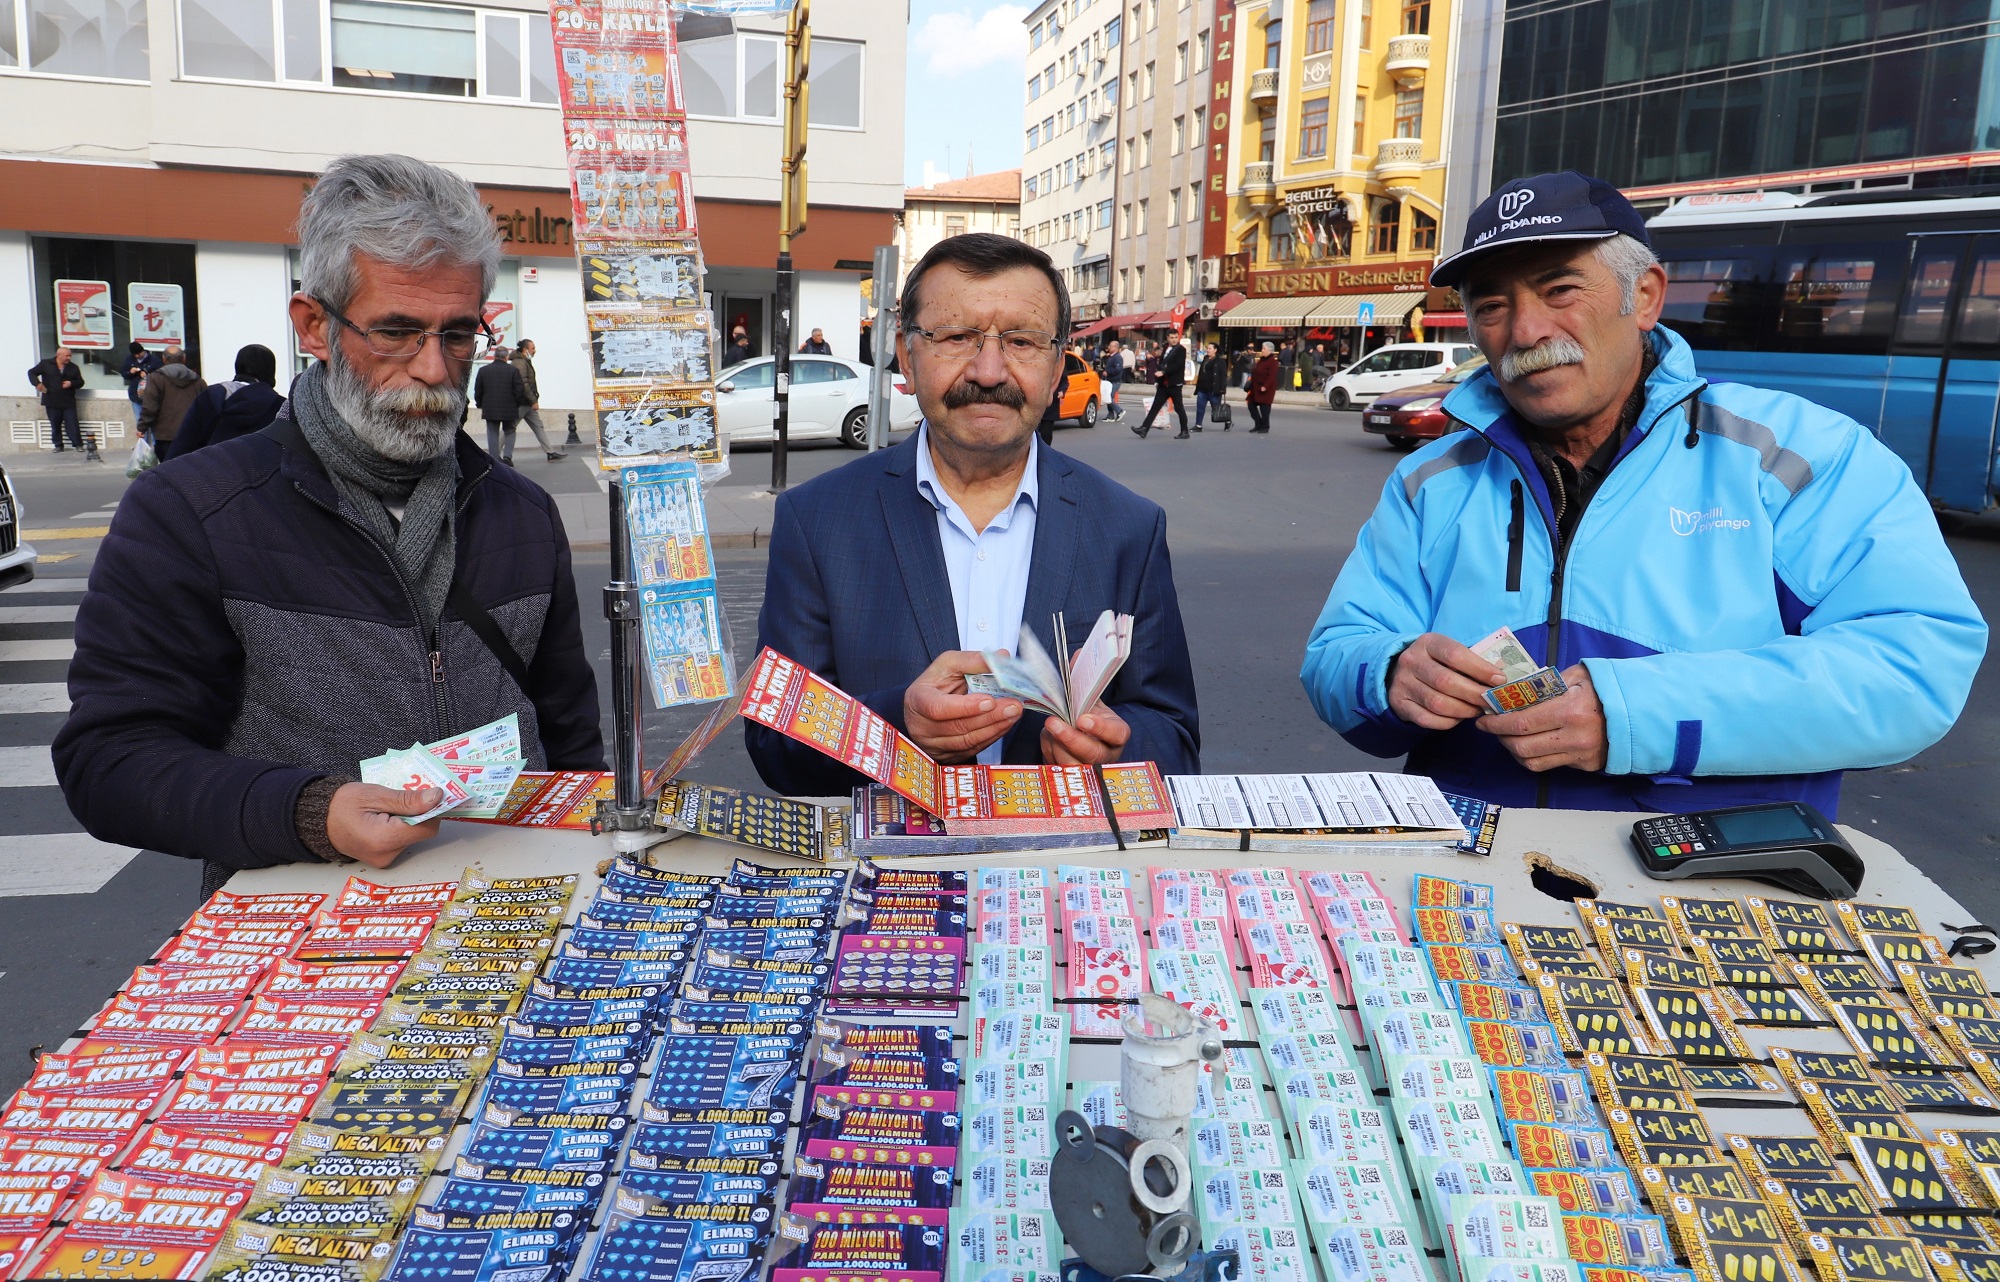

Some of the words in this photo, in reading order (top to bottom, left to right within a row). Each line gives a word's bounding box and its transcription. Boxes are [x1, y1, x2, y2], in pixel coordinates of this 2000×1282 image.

[602, 12, 669, 31] KATLA
[616, 133, 682, 151] KATLA
[1211, 81, 1229, 222] HOTEL
[1285, 187, 1334, 203] BERLİTZ
[486, 204, 572, 245] atılım
[1501, 215, 1562, 232] PİYANGO
[1254, 271, 1331, 295] RUŞEN
[1337, 266, 1426, 287] Pastaneleri
[766, 658, 794, 698] KATLA
[1504, 685, 1526, 706] 500
[866, 715, 886, 752] KATLA
[958, 767, 975, 797] KATLA
[1065, 767, 1086, 797] KATLA
[385, 891, 449, 905] KATLA
[245, 903, 312, 914] KATLA
[476, 907, 509, 917] MEGA
[511, 907, 547, 916] ALTIN
[354, 926, 423, 938] KATLA
[1430, 909, 1449, 943] 500
[226, 931, 294, 943] KATLA
[443, 961, 480, 973] MEGA
[481, 961, 519, 972] ALTIN
[1443, 946, 1465, 980] 500
[174, 976, 249, 993] KATLA
[316, 976, 389, 989] KATLA
[409, 982, 502, 992] 4.000.000
[1473, 985, 1492, 1018] 500
[148, 1015, 221, 1032] KATLA
[289, 1016, 364, 1033] KATLA
[748, 1038, 790, 1048] ELMAS
[1485, 1022, 1508, 1066] 500
[387, 1045, 428, 1059] MEGA
[429, 1046, 472, 1059] ALTIN
[755, 1050, 784, 1059] YEDİ
[85, 1062, 170, 1082] KATLA
[244, 1059, 325, 1080] KATLA
[349, 1069, 451, 1080] 4.000.000
[222, 1094, 306, 1113] KATLA
[1512, 1071, 1538, 1121] 500
[53, 1111, 139, 1129] KATLA
[697, 1110, 755, 1123] 4.000.000
[845, 1111, 865, 1125] 100
[867, 1110, 908, 1128] MİLYON
[562, 1134, 609, 1146] ELMAS
[726, 1128, 772, 1140] ELMAS
[333, 1134, 378, 1152] MEGA
[379, 1136, 426, 1152] ALTIN
[734, 1141, 764, 1151] YEDİ
[567, 1147, 599, 1158] YEDİ
[13, 1154, 102, 1177] KATLA
[182, 1153, 265, 1180] KATLA
[714, 1179, 762, 1191] ELMAS
[830, 1168, 853, 1185] 100
[854, 1167, 897, 1187] MİLYON
[899, 1169, 913, 1188] TL
[156, 1188, 209, 1203] 1.000.000
[300, 1180, 348, 1196] MEGA
[349, 1180, 397, 1196] ALTIN
[828, 1188, 857, 1196] PARA
[860, 1188, 911, 1198] YAĞMURU
[285, 1203, 320, 1211] BÜYÜK
[322, 1203, 370, 1211] İKRAMİYE
[857, 1198, 901, 1206] 2.000.000
[1680, 1204, 1688, 1213] 10
[136, 1204, 229, 1228] KATLA
[256, 1210, 371, 1223] 4.000.000
[372, 1214, 386, 1222] TL
[475, 1213, 540, 1229] 4.000.000
[672, 1205, 738, 1221] 4.000.000
[703, 1227, 755, 1240] ELMAS
[1465, 1224, 1476, 1237] 50
[270, 1235, 317, 1255] MEGA
[318, 1237, 371, 1260] ALTIN
[502, 1234, 555, 1249] ELMAS
[814, 1230, 839, 1248] 100
[840, 1229, 885, 1249] MİLYON
[888, 1230, 902, 1250] TL
[709, 1242, 745, 1255] YEDİ
[813, 1251, 842, 1260] PARA
[846, 1251, 900, 1260] YAĞMURU
[509, 1251, 544, 1263] YEDİ
[843, 1261, 891, 1269] 2.000.000
